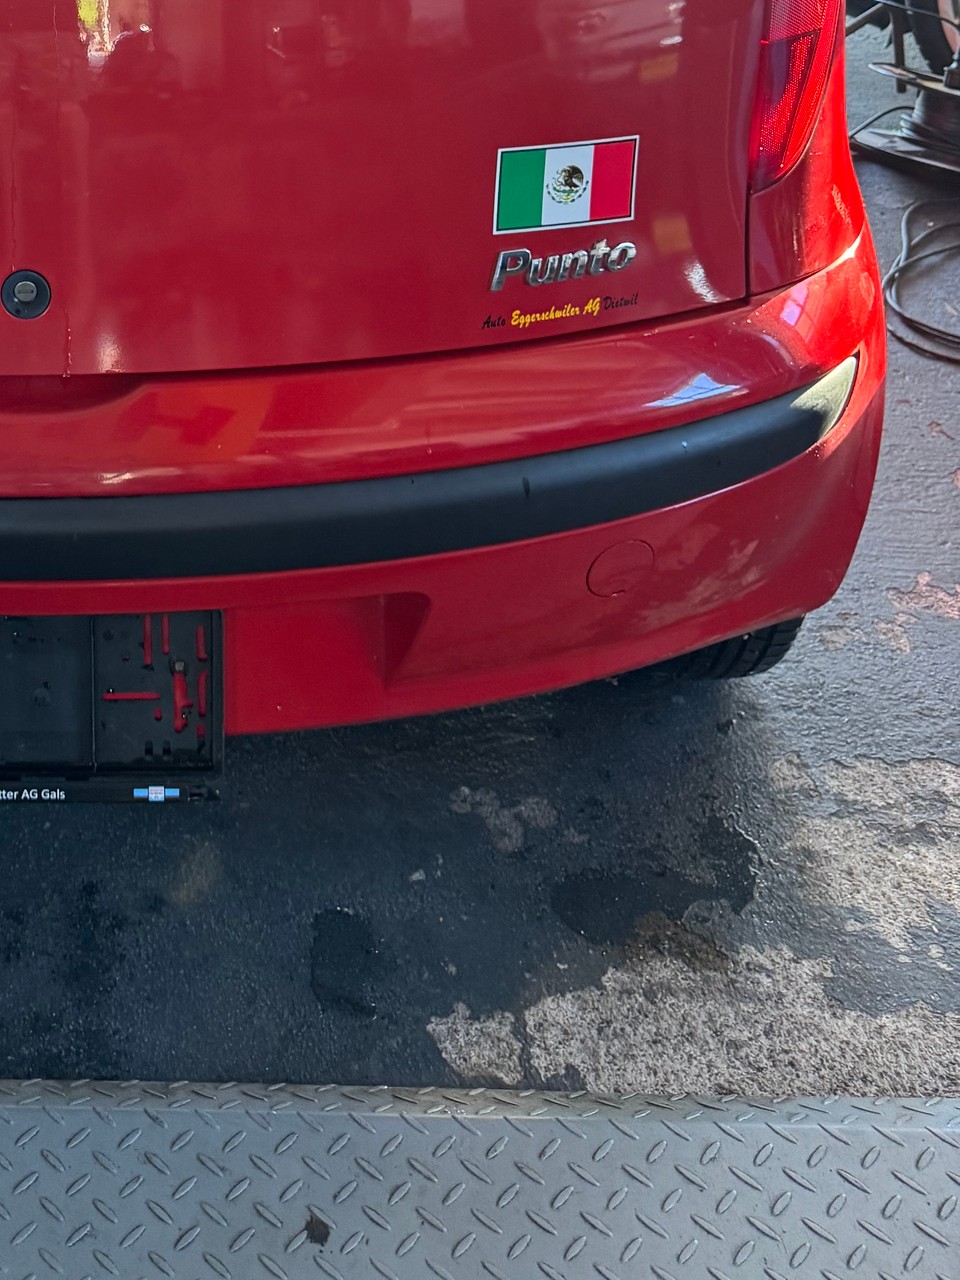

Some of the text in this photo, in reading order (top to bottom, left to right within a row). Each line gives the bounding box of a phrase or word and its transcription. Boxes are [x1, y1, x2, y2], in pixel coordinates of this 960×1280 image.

[490, 239, 638, 292] Punto
[481, 293, 639, 329] Auto Eggerschwiler AG Dietwil
[21, 788, 38, 800] AG
[41, 788, 66, 800] Gals
